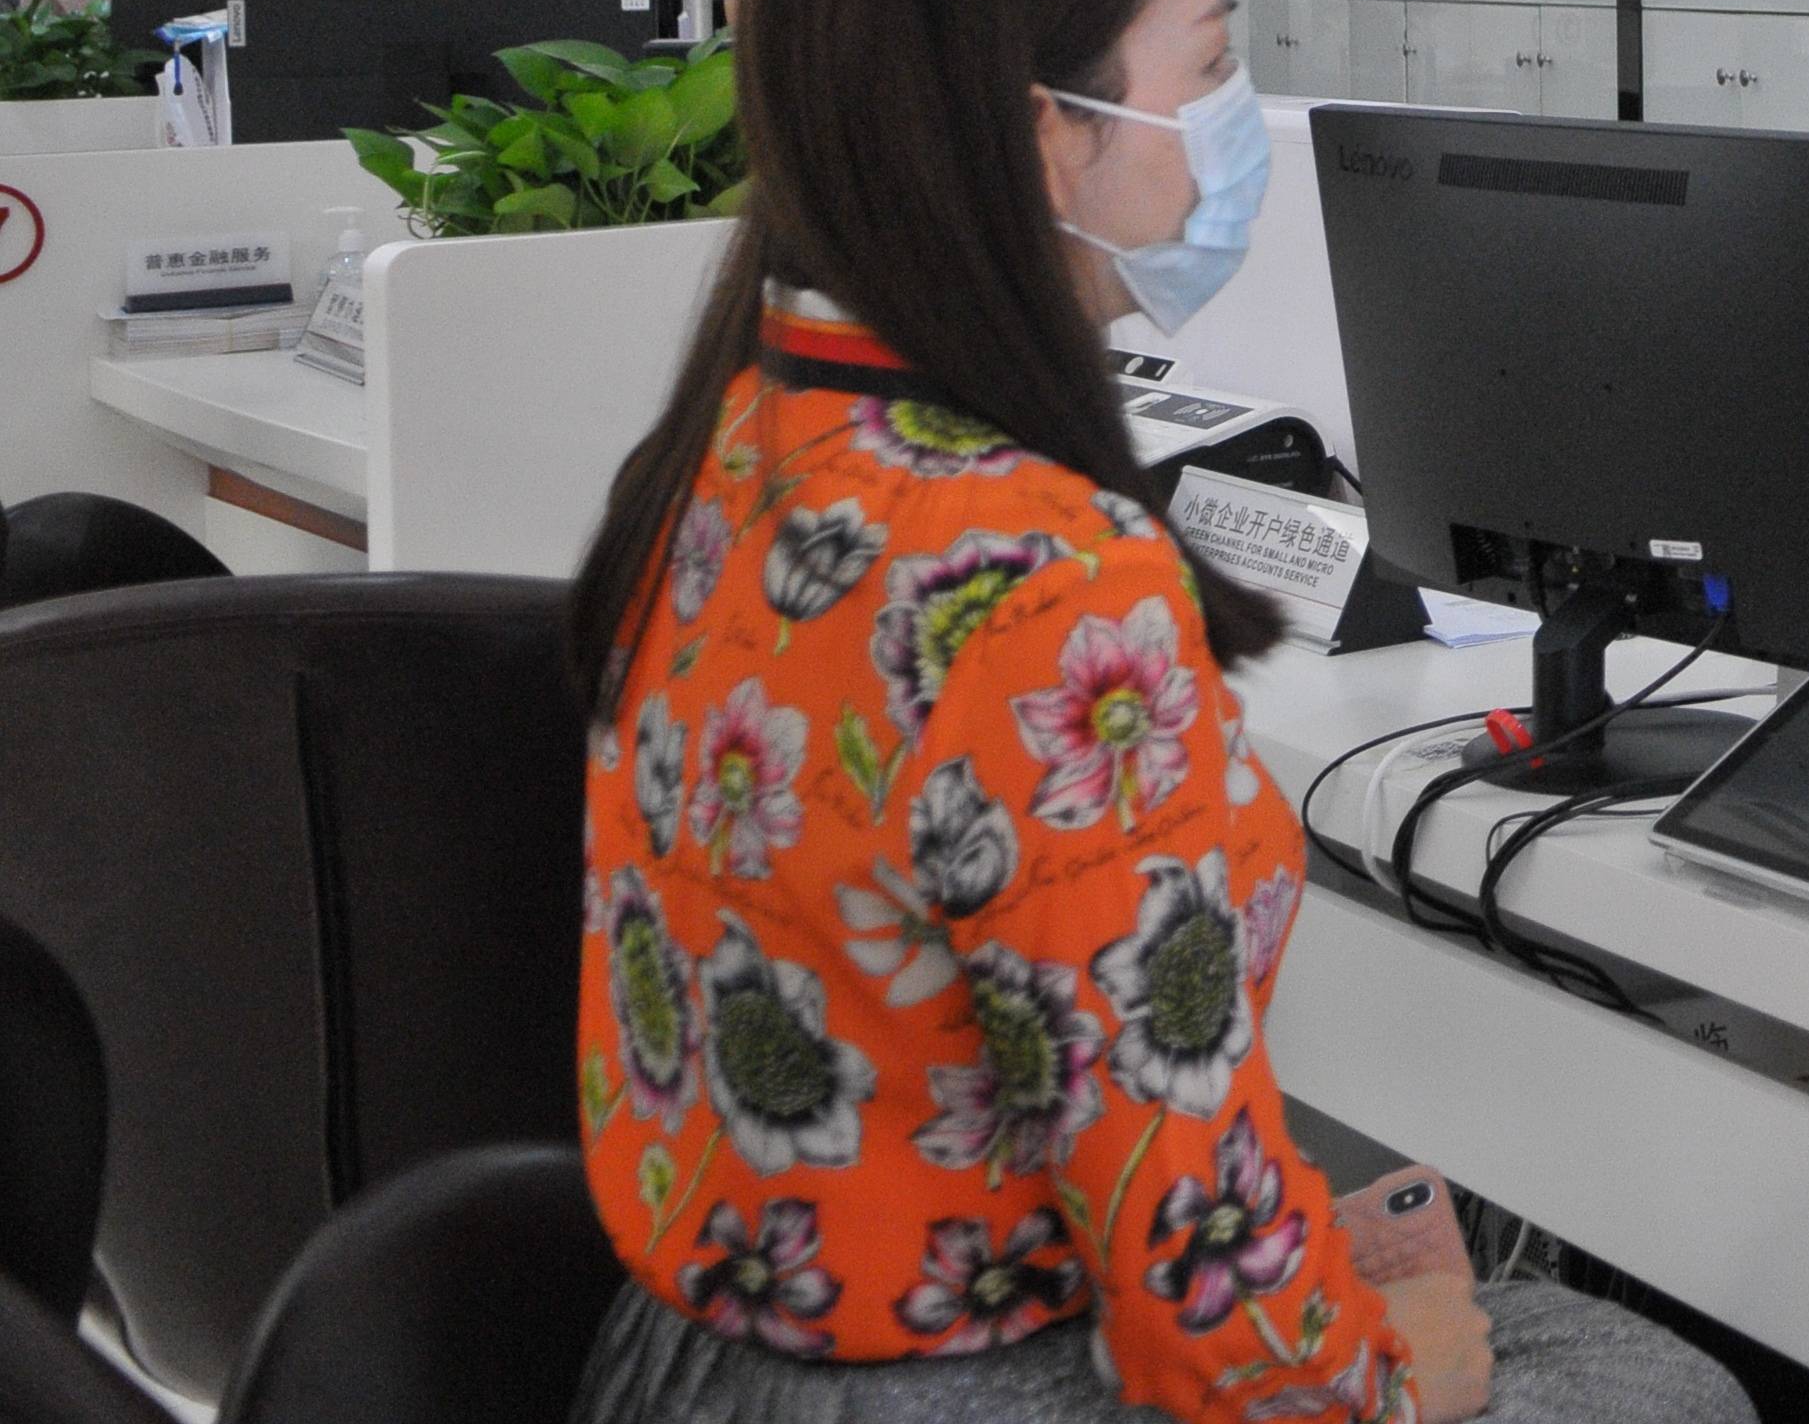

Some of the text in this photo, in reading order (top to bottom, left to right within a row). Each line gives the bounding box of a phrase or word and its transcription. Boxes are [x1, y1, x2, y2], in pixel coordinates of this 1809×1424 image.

[145, 246, 271, 270] 普惠金融服务
[1184, 494, 1350, 563] 小微企业开户绿色通道
[1210, 533, 1245, 552] CHANNEL
[1246, 542, 1263, 555] FOR
[1263, 547, 1288, 564] SMALL
[1288, 554, 1307, 569] AND
[1307, 560, 1334, 575] MICRO
[1241, 557, 1284, 577] ACCOUNTS
[1283, 569, 1320, 588] SERVICE
